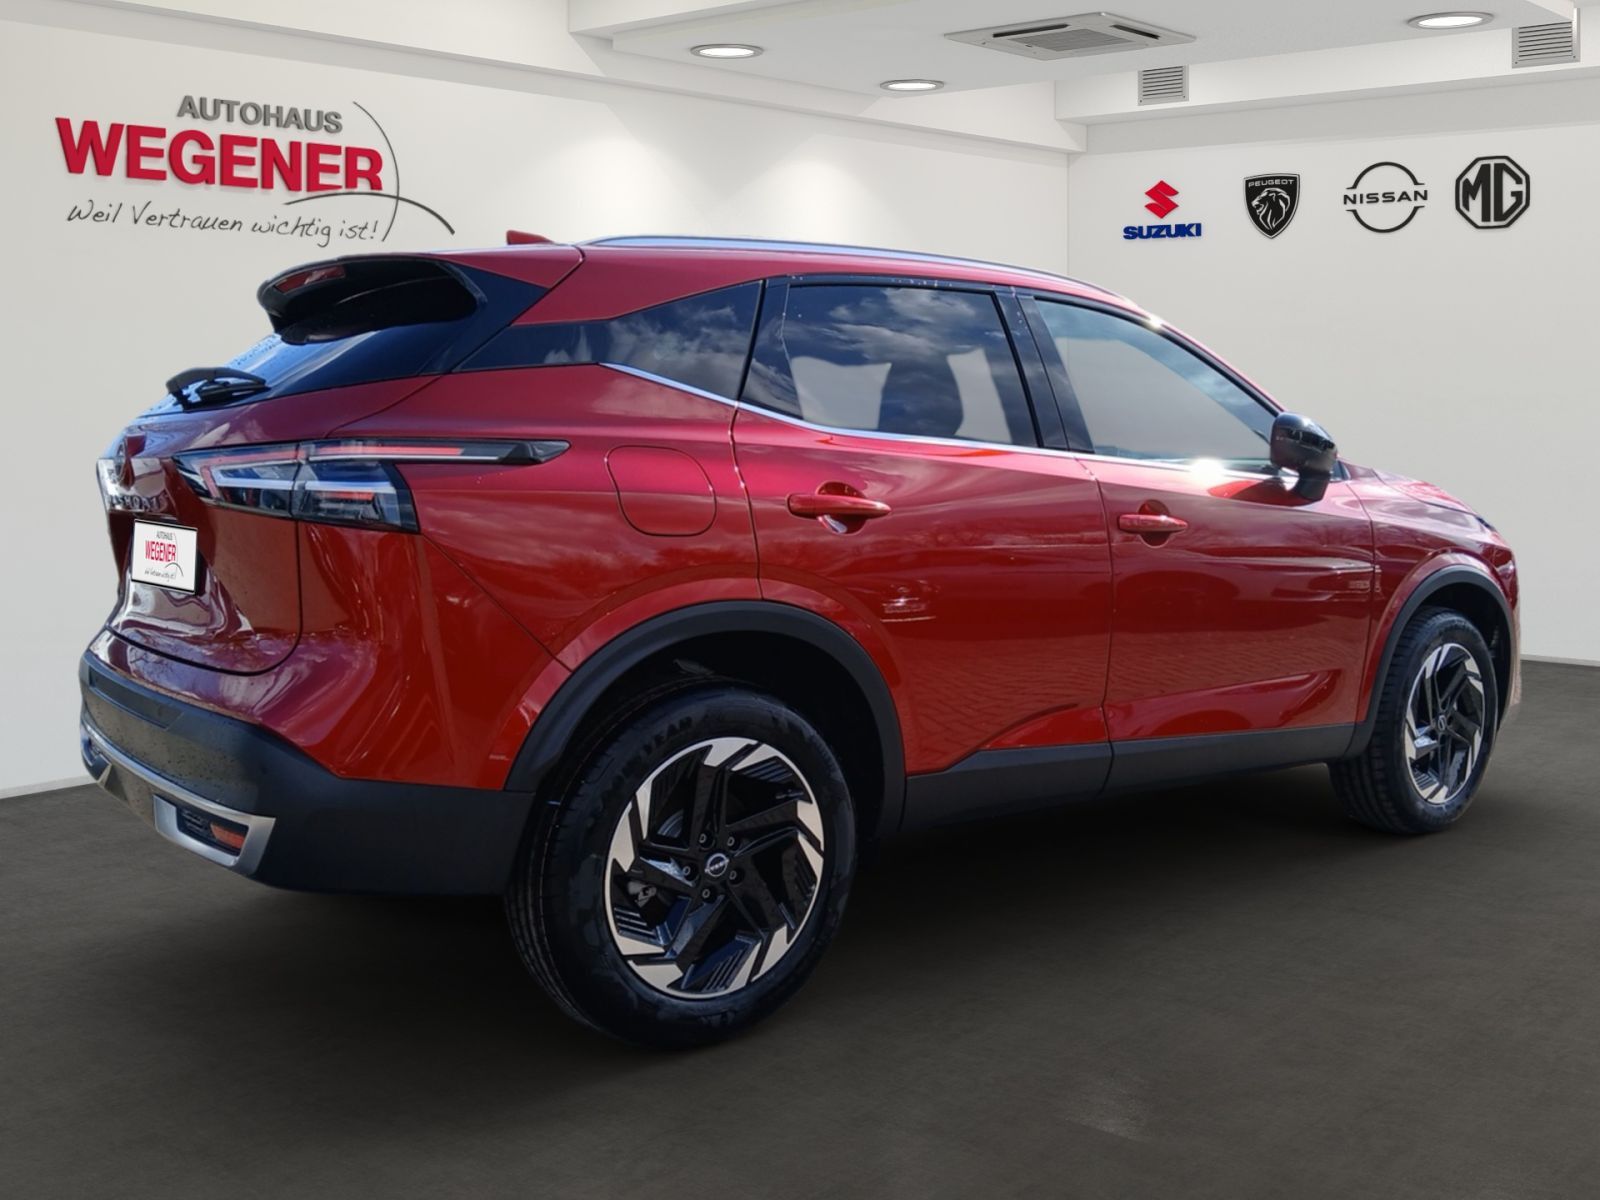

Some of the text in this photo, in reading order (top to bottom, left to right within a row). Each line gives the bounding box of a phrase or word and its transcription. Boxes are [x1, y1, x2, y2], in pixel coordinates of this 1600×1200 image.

[177, 95, 342, 133] AUTOHAUS
[55, 117, 384, 193] WEGENER
[1248, 179, 1295, 188] PEUGEOT
[1343, 189, 1428, 205] NISSAN
[1463, 163, 1523, 222] MG
[67, 199, 378, 248] Weil Vertrauen wichtig ist!
[1123, 223, 1202, 240] SUZUKI
[145, 540, 176, 562] WEGENER
